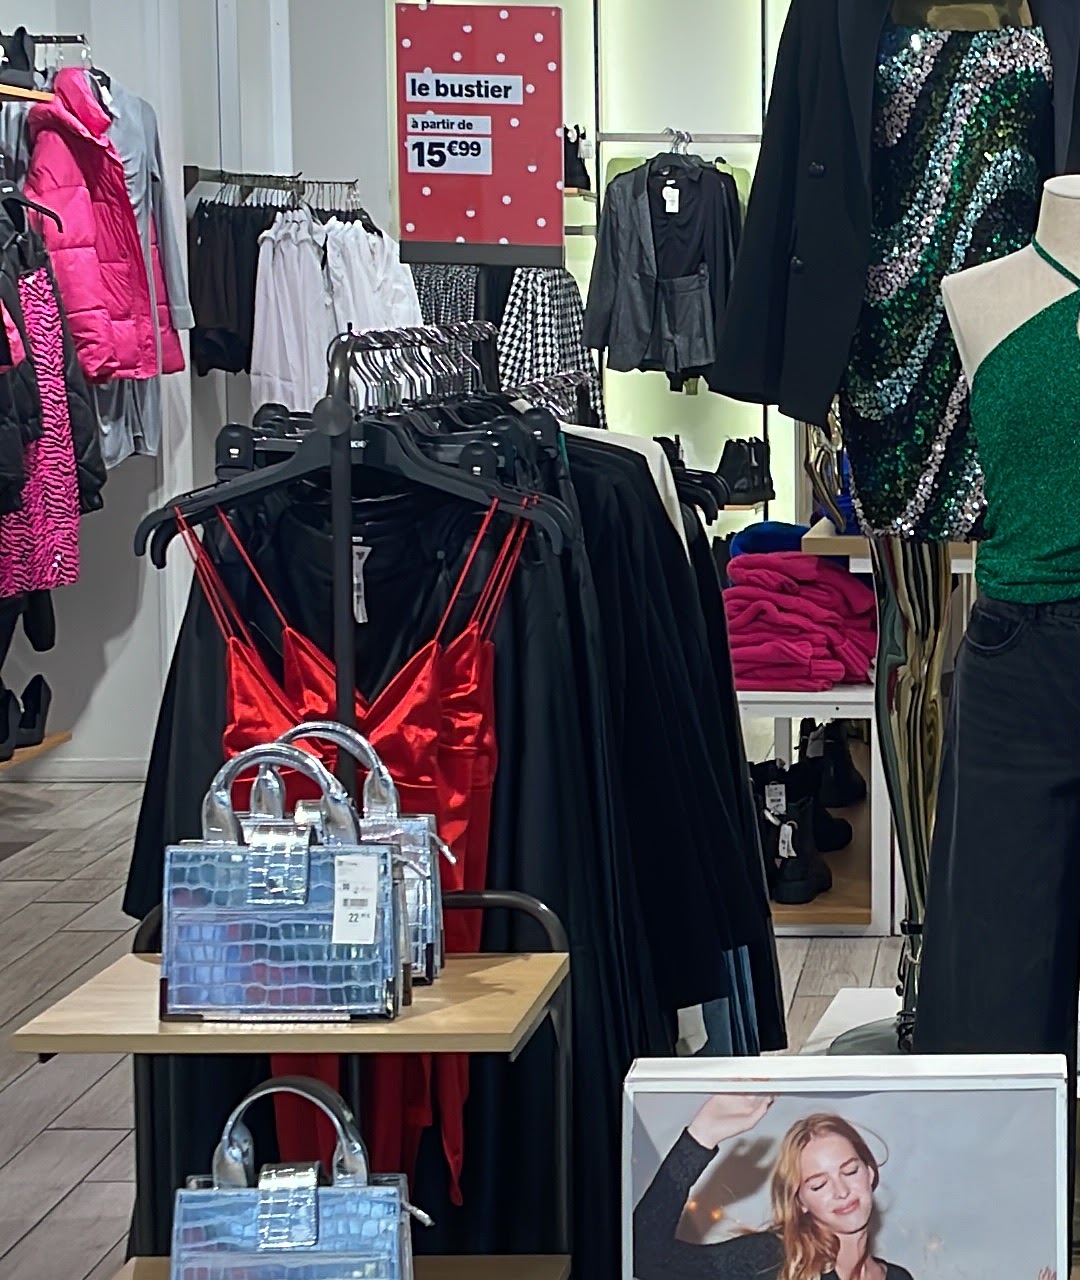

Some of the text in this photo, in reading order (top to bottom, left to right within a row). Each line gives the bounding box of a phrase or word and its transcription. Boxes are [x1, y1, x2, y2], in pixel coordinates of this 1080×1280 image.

[411, 78, 512, 99] le bustier
[411, 118, 474, 132] à partir de
